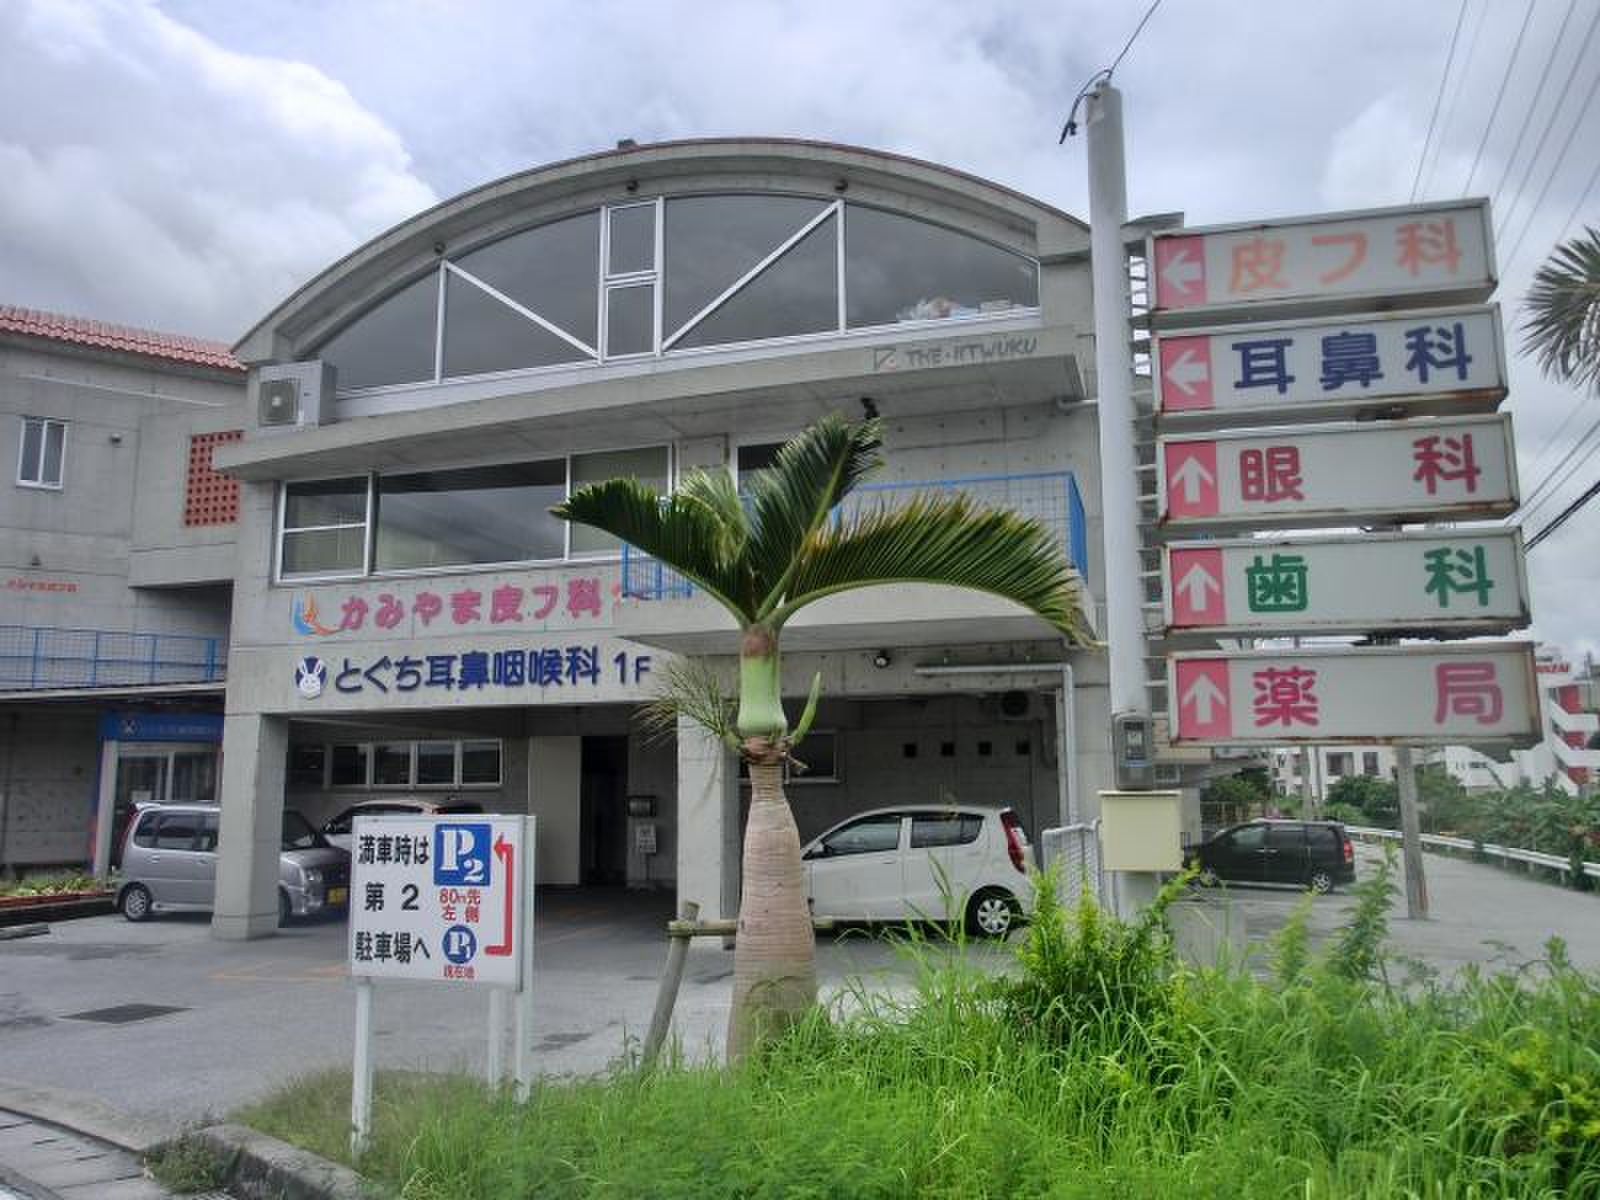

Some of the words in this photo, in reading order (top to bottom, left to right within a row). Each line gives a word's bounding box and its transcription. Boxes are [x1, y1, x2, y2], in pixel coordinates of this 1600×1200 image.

[1229, 218, 1464, 294] 皮フ科
[1231, 322, 1473, 395] 耳鼻科
[1239, 433, 1483, 502] 眼科
[340, 578, 601, 630] かみやま皮フ科
[1245, 545, 1495, 613] 歯科
[335, 645, 601, 693] とぐち耳鼻咽喉科
[613, 650, 652, 685] 1F
[1252, 661, 1503, 728] 薬局
[358, 834, 430, 866] 満車時は
[355, 931, 431, 964] 駐車場へ
